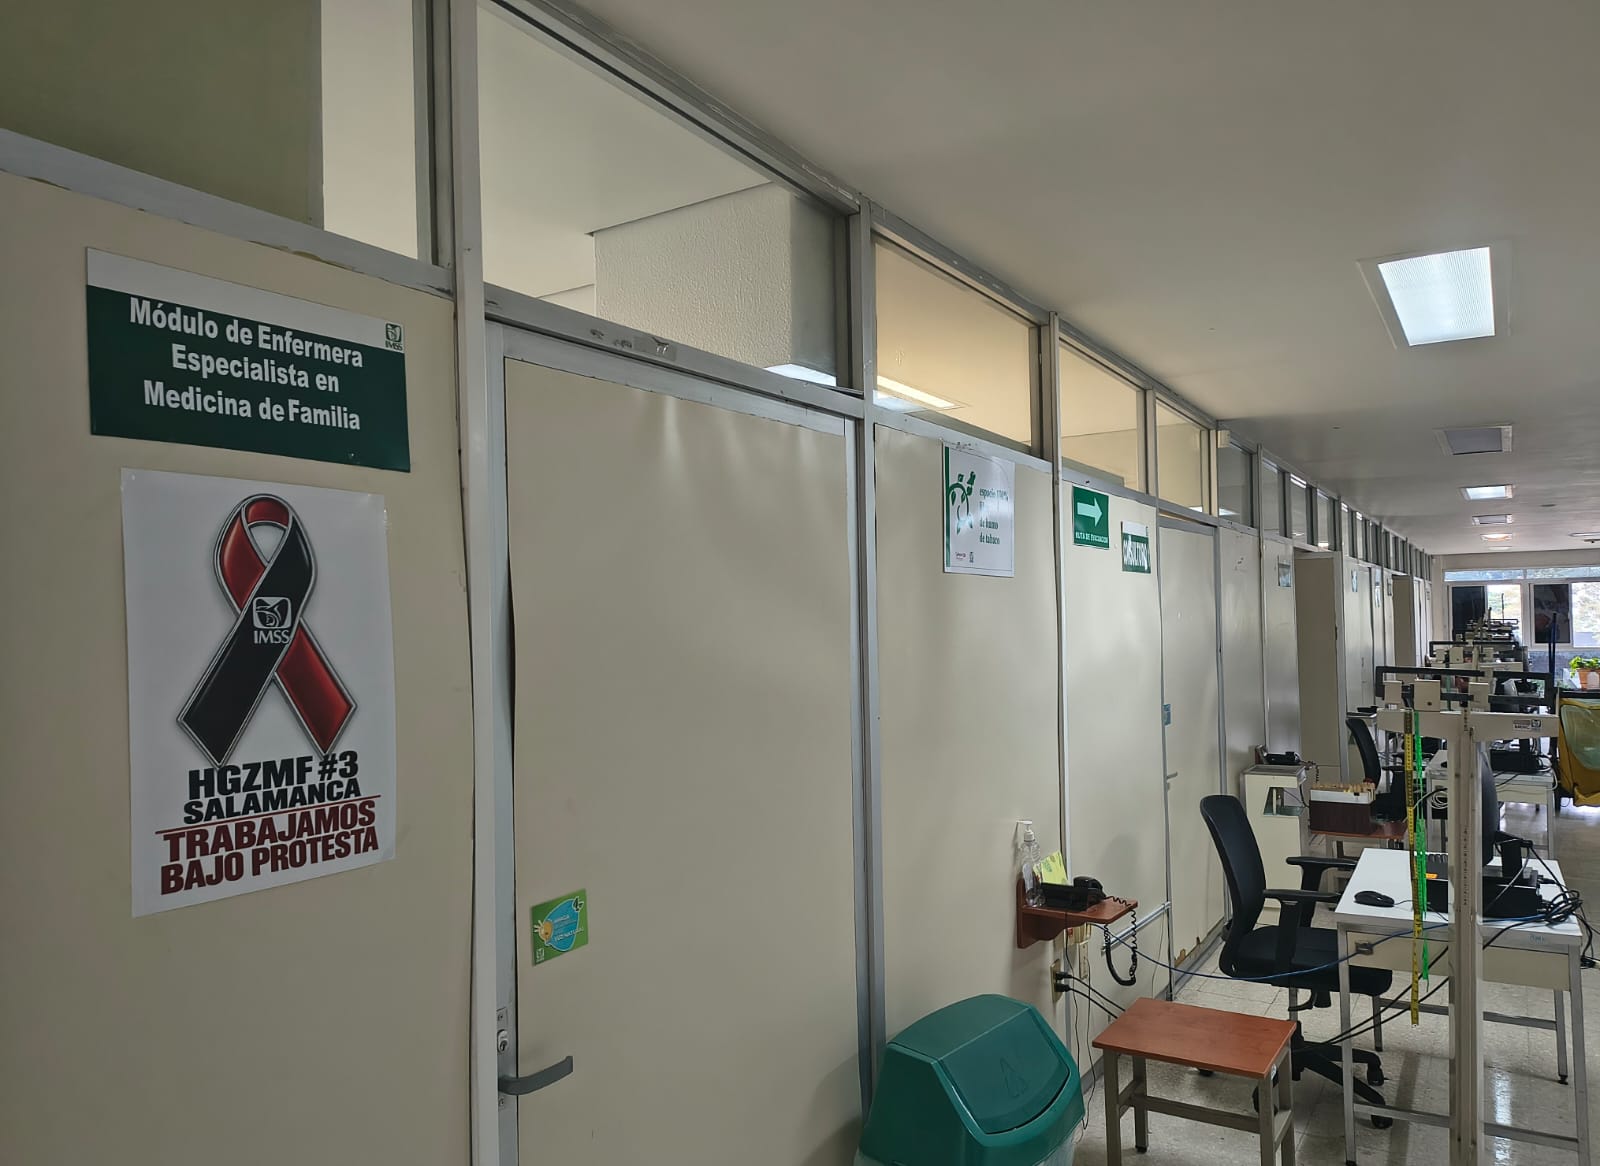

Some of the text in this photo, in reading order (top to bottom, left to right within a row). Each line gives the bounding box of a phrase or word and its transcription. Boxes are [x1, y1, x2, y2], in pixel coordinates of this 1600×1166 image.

[130, 297, 363, 367] Módulo de Enfermera
[172, 344, 339, 393] Especialista en
[144, 380, 361, 430] Medicina de Familia
[253, 629, 290, 644] IMSS
[188, 750, 358, 800] HGZMF #3
[183, 778, 361, 825] SALAMANCA
[163, 800, 376, 862] TRABAJAMOS
[161, 826, 379, 895] BAJO PROTESTA
